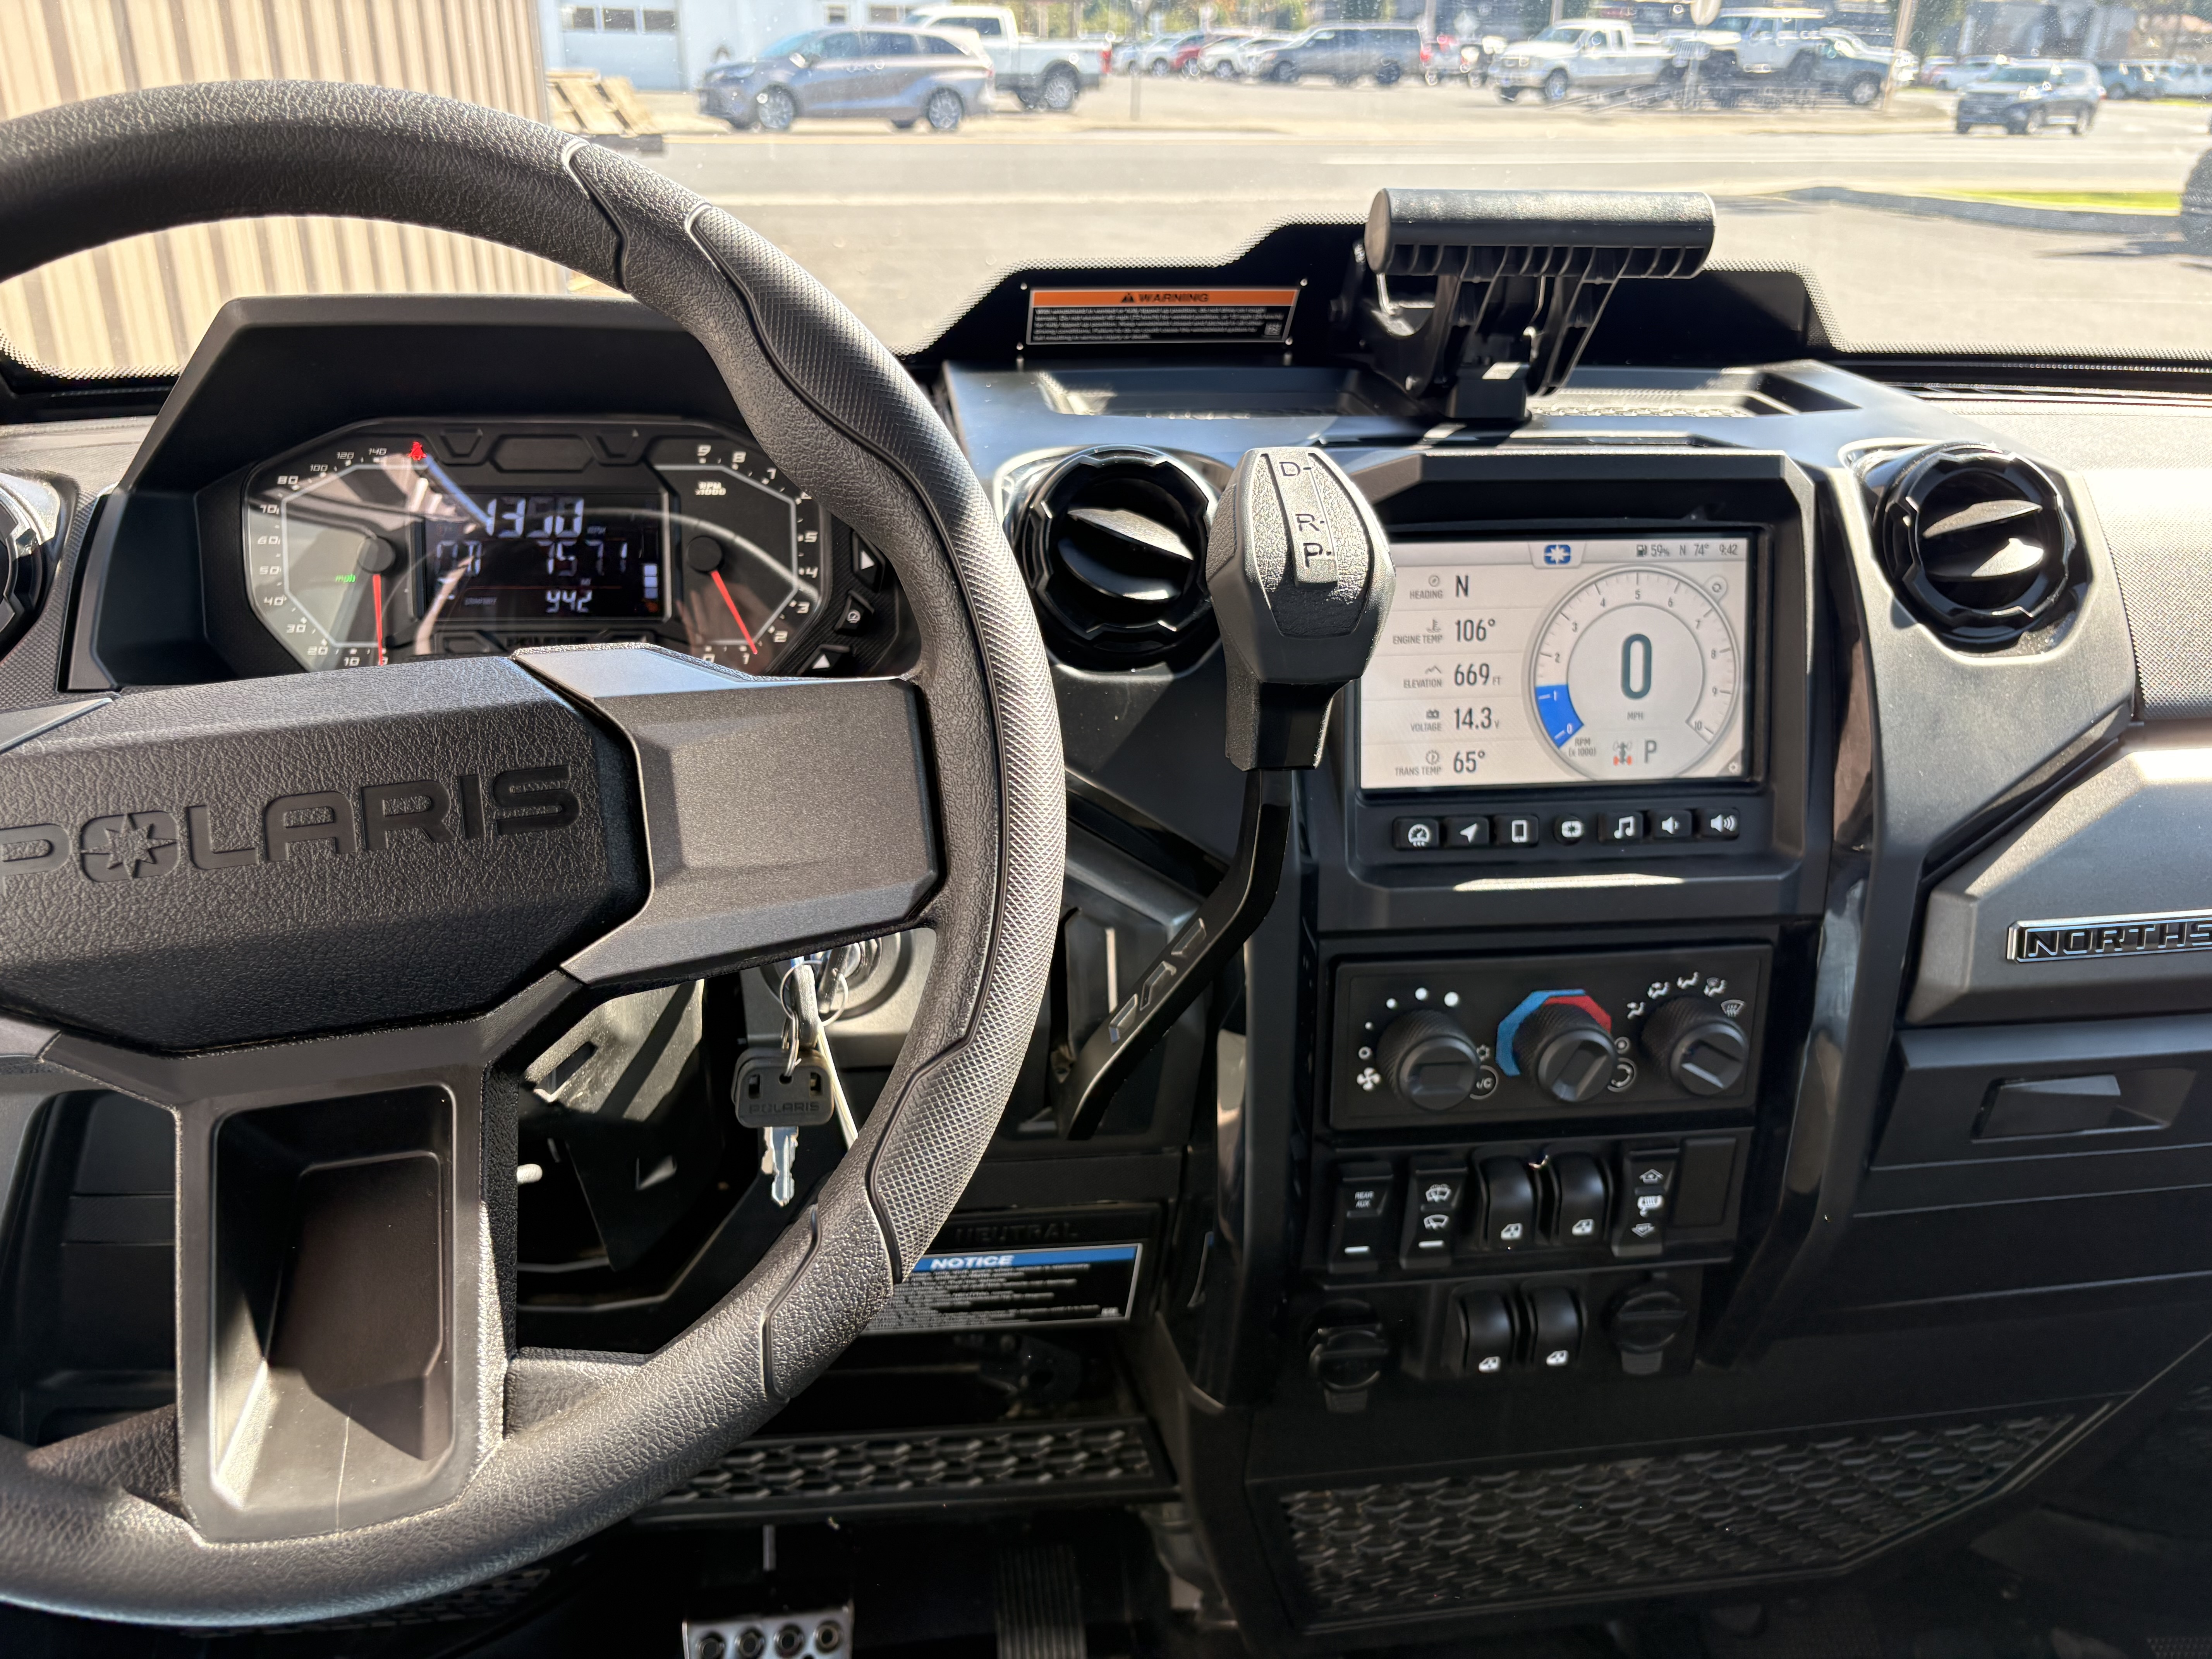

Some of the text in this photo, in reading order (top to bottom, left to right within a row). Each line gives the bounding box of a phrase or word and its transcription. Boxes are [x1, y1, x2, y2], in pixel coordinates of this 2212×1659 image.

[1139, 293, 1209, 302] WARNING
[368, 448, 387, 456] 140
[697, 445, 711, 456] 9
[337, 452, 355, 460] 120
[732, 451, 747, 463] 8
[767, 467, 776, 479] 7
[1279, 461, 1301, 477] D
[277, 475, 299, 484] 80
[698, 481, 722, 490] RPM
[259, 504, 278, 514] 70
[1295, 513, 1320, 532] R
[805, 531, 818, 542] 5
[1303, 542, 1322, 568] P
[1680, 545, 1686, 556] N
[259, 566, 280, 575] 50
[806, 567, 818, 578] 4
[335, 574, 356, 584] mph
[1455, 575, 1469, 597] N
[1409, 590, 1443, 600] HEADING
[1635, 590, 1641, 599] 5
[264, 596, 284, 606] 40
[1600, 598, 1606, 607] 4
[1668, 598, 1673, 607] 6
[797, 602, 810, 613] 3
[286, 624, 307, 633] 30
[1572, 622, 1578, 632] 3
[1695, 620, 1701, 629] 7
[1455, 618, 1495, 642] 106°
[774, 630, 788, 642] 2
[1393, 634, 1443, 645] ENGINE TEMP
[307, 646, 328, 656] 20
[1711, 649, 1716, 658] 8
[343, 657, 360, 666] 10
[743, 653, 750, 665] 1
[1554, 653, 1561, 663] 2
[1621, 633, 1652, 701] 0
[1454, 663, 1490, 686] 669
[1403, 679, 1442, 689] ELEVATION
[1553, 691, 1557, 701] 1
[1712, 687, 1717, 696] 9
[1454, 707, 1492, 730] 14.3
[1627, 711, 1644, 720] MPH
[1410, 723, 1442, 732] VOLTAGE
[1566, 723, 1573, 735] 0
[1694, 721, 1702, 730] 10
[1574, 737, 1590, 747] RPM
[1645, 740, 1657, 764] P
[1453, 750, 1486, 774] 65°
[1395, 766, 1441, 776] TRANS TEMP
[749, 1101, 820, 1115] POLARIS
[1355, 1191, 1374, 1200] REAR
[1356, 1200, 1371, 1208] AUX
[930, 1255, 1015, 1270] NOTICE
